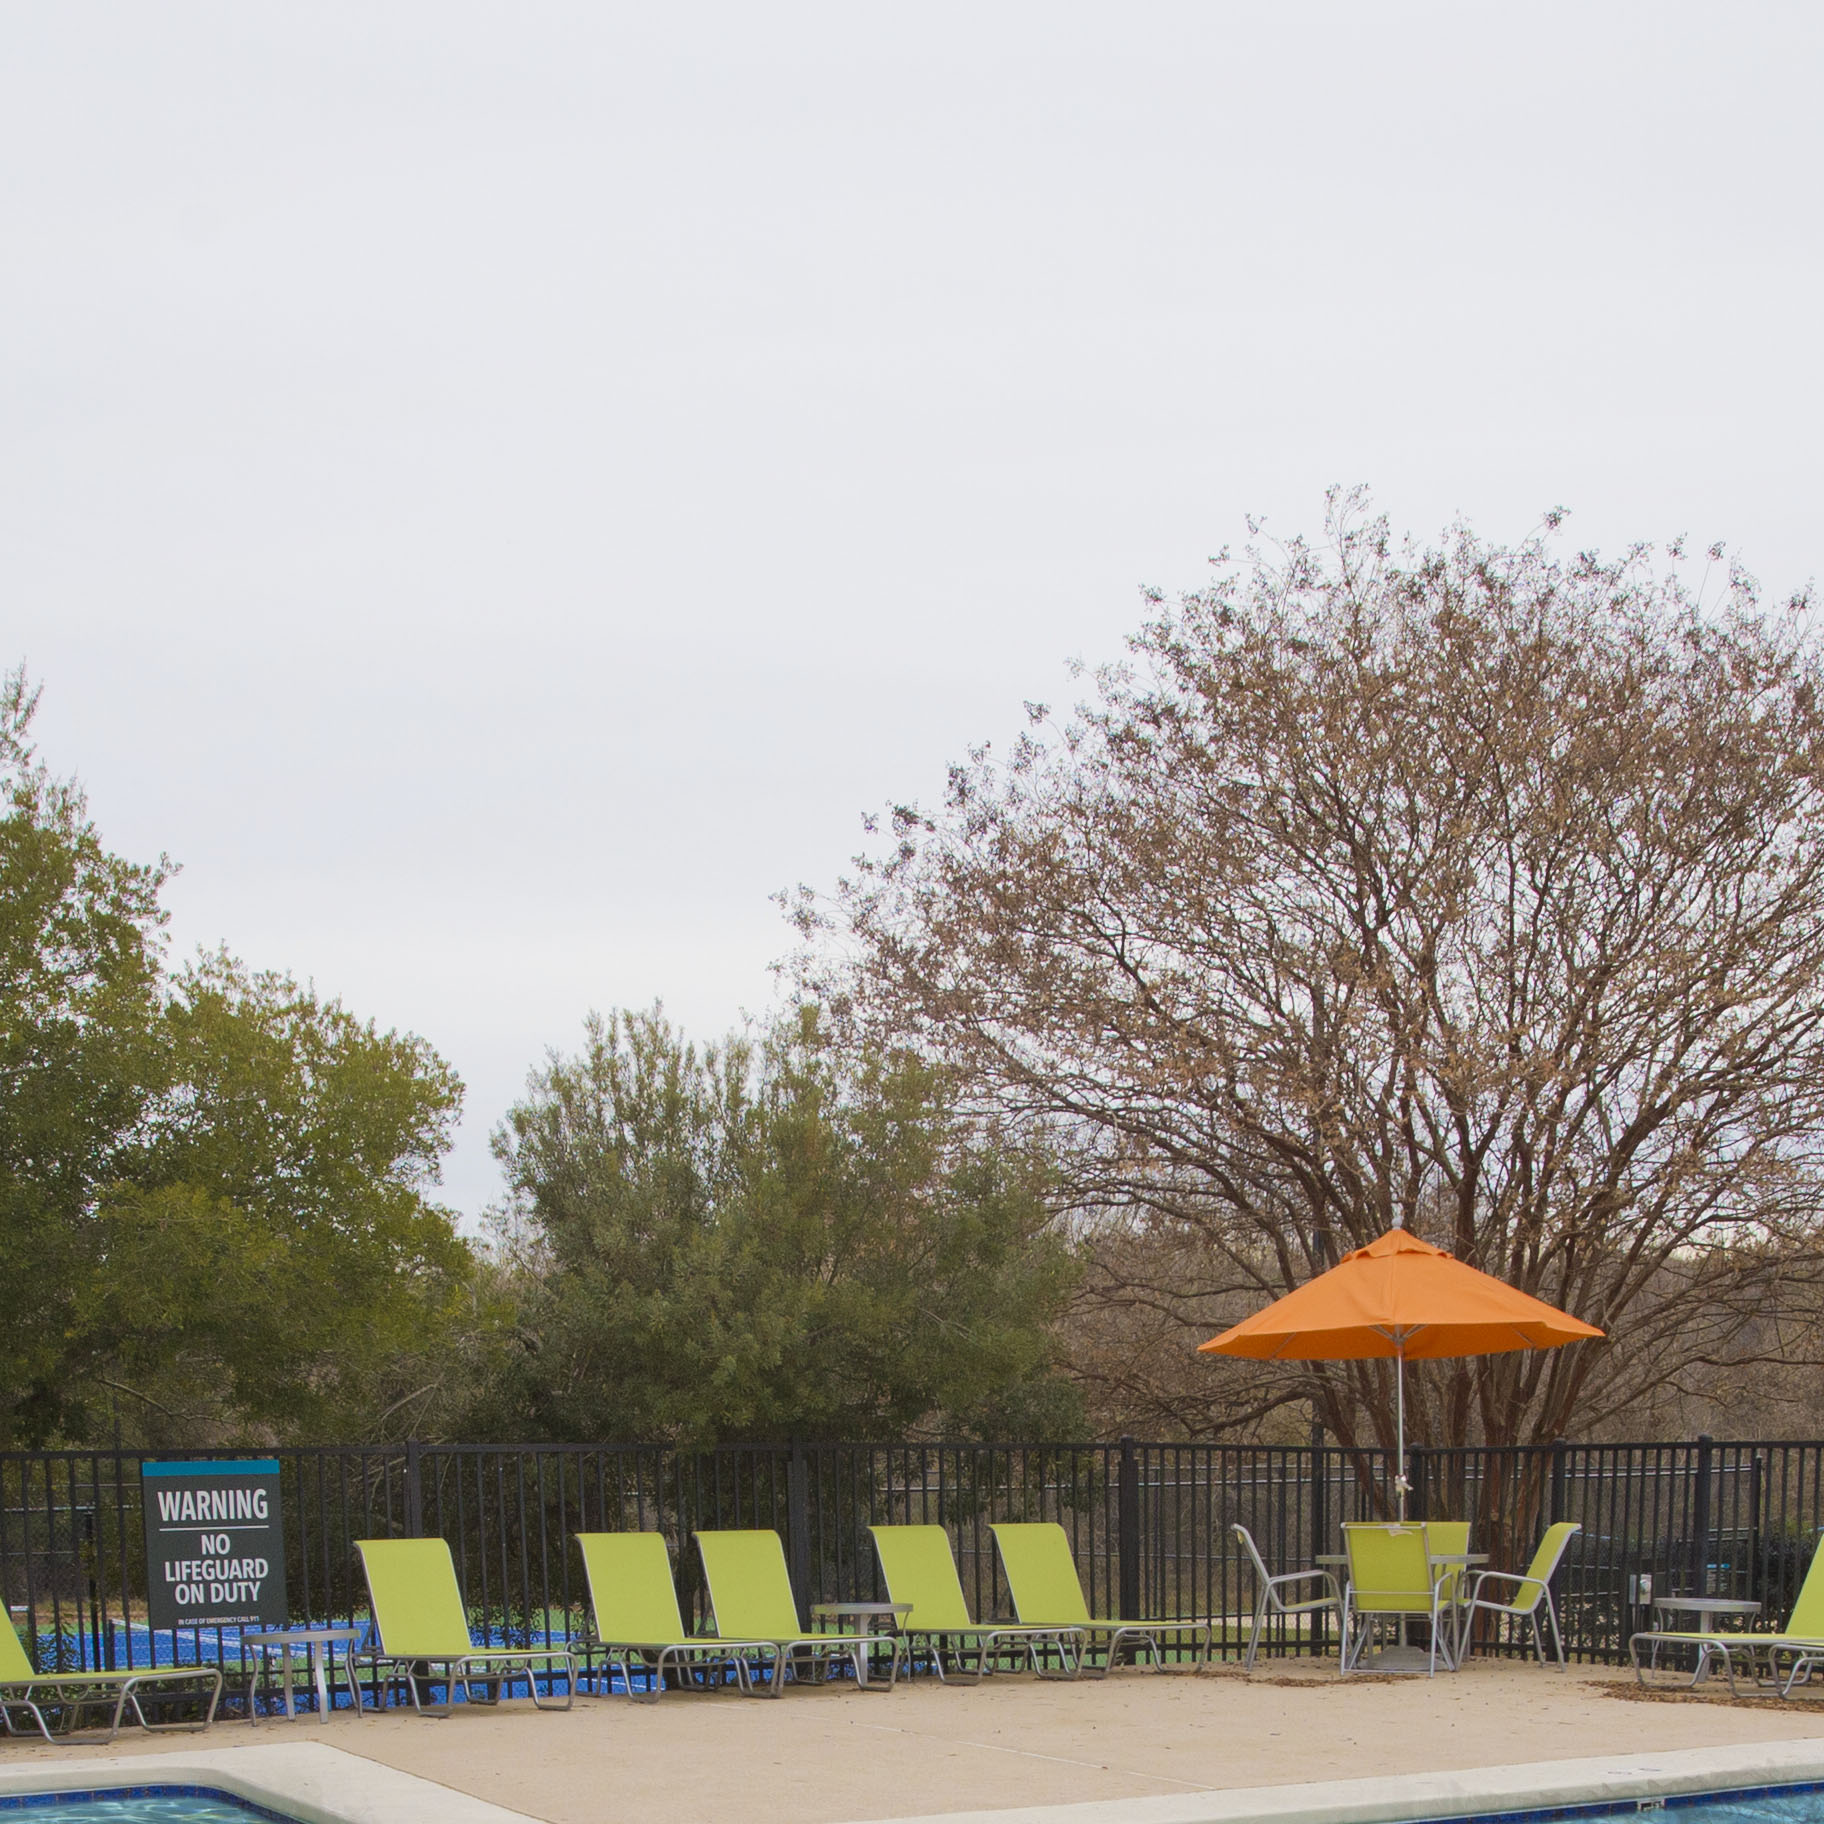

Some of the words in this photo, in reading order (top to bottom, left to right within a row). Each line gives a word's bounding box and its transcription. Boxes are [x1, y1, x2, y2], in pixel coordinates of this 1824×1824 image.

[157, 1488, 269, 1522] WARNING
[201, 1533, 231, 1556] NO
[164, 1558, 269, 1583] LIFEGUARD
[175, 1583, 205, 1605] ON
[210, 1580, 261, 1604] DUTY
